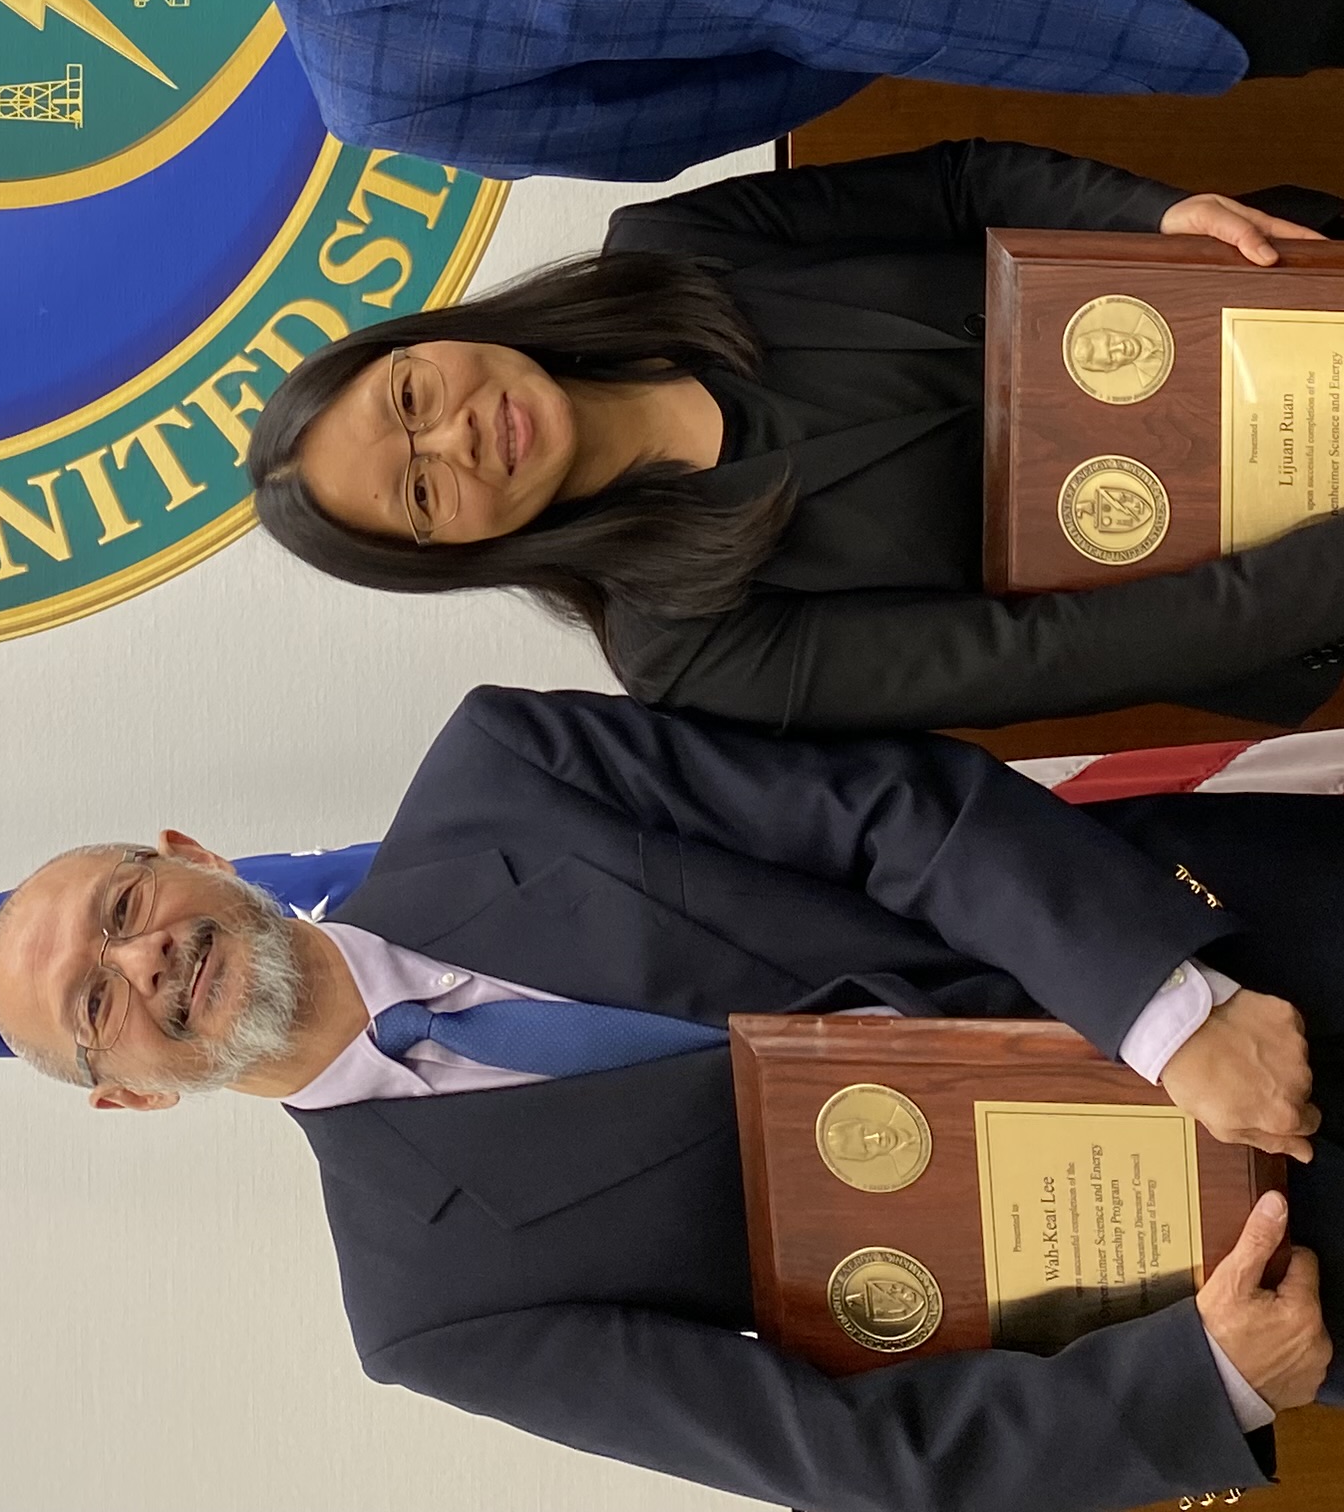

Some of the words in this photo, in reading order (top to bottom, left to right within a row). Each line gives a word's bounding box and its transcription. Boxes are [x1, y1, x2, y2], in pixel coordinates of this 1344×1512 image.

[1307, 371, 1315, 384] the
[1329, 352, 1343, 389] Energy
[1306, 385, 1314, 395] of
[1329, 393, 1340, 412] and
[1250, 413, 1258, 421] to
[1279, 394, 1294, 432] Ruan
[1306, 397, 1316, 443] completion
[1249, 424, 1258, 464] Presented
[1329, 416, 1340, 457] Science
[1278, 438, 1297, 486] Lijuan
[1306, 446, 1314, 488] successful
[1307, 490, 1315, 511] upon
[1067, 1162, 1075, 1175] the
[1090, 1144, 1102, 1180] Energy
[1131, 1154, 1140, 1186] Council
[1041, 1177, 1055, 1204] Lee
[1067, 1177, 1076, 1186] of
[1091, 1184, 1102, 1202] and
[1147, 1179, 1156, 1207] Energy
[1012, 1204, 1019, 1212] to
[1069, 1188, 1080, 1233] completion
[1110, 1179, 1123, 1224] Program
[1147, 1209, 1156, 1218] of
[1012, 1215, 1021, 1252] Presented
[1095, 1206, 1106, 1246] Science
[1148, 1221, 1160, 1267] Department
[1042, 1209, 1059, 1281] Wah-Keat
[1071, 1235, 1081, 1276] successful
[1112, 1227, 1126, 1284] Leadership
[1135, 1231, 1146, 1274] Laboratory
